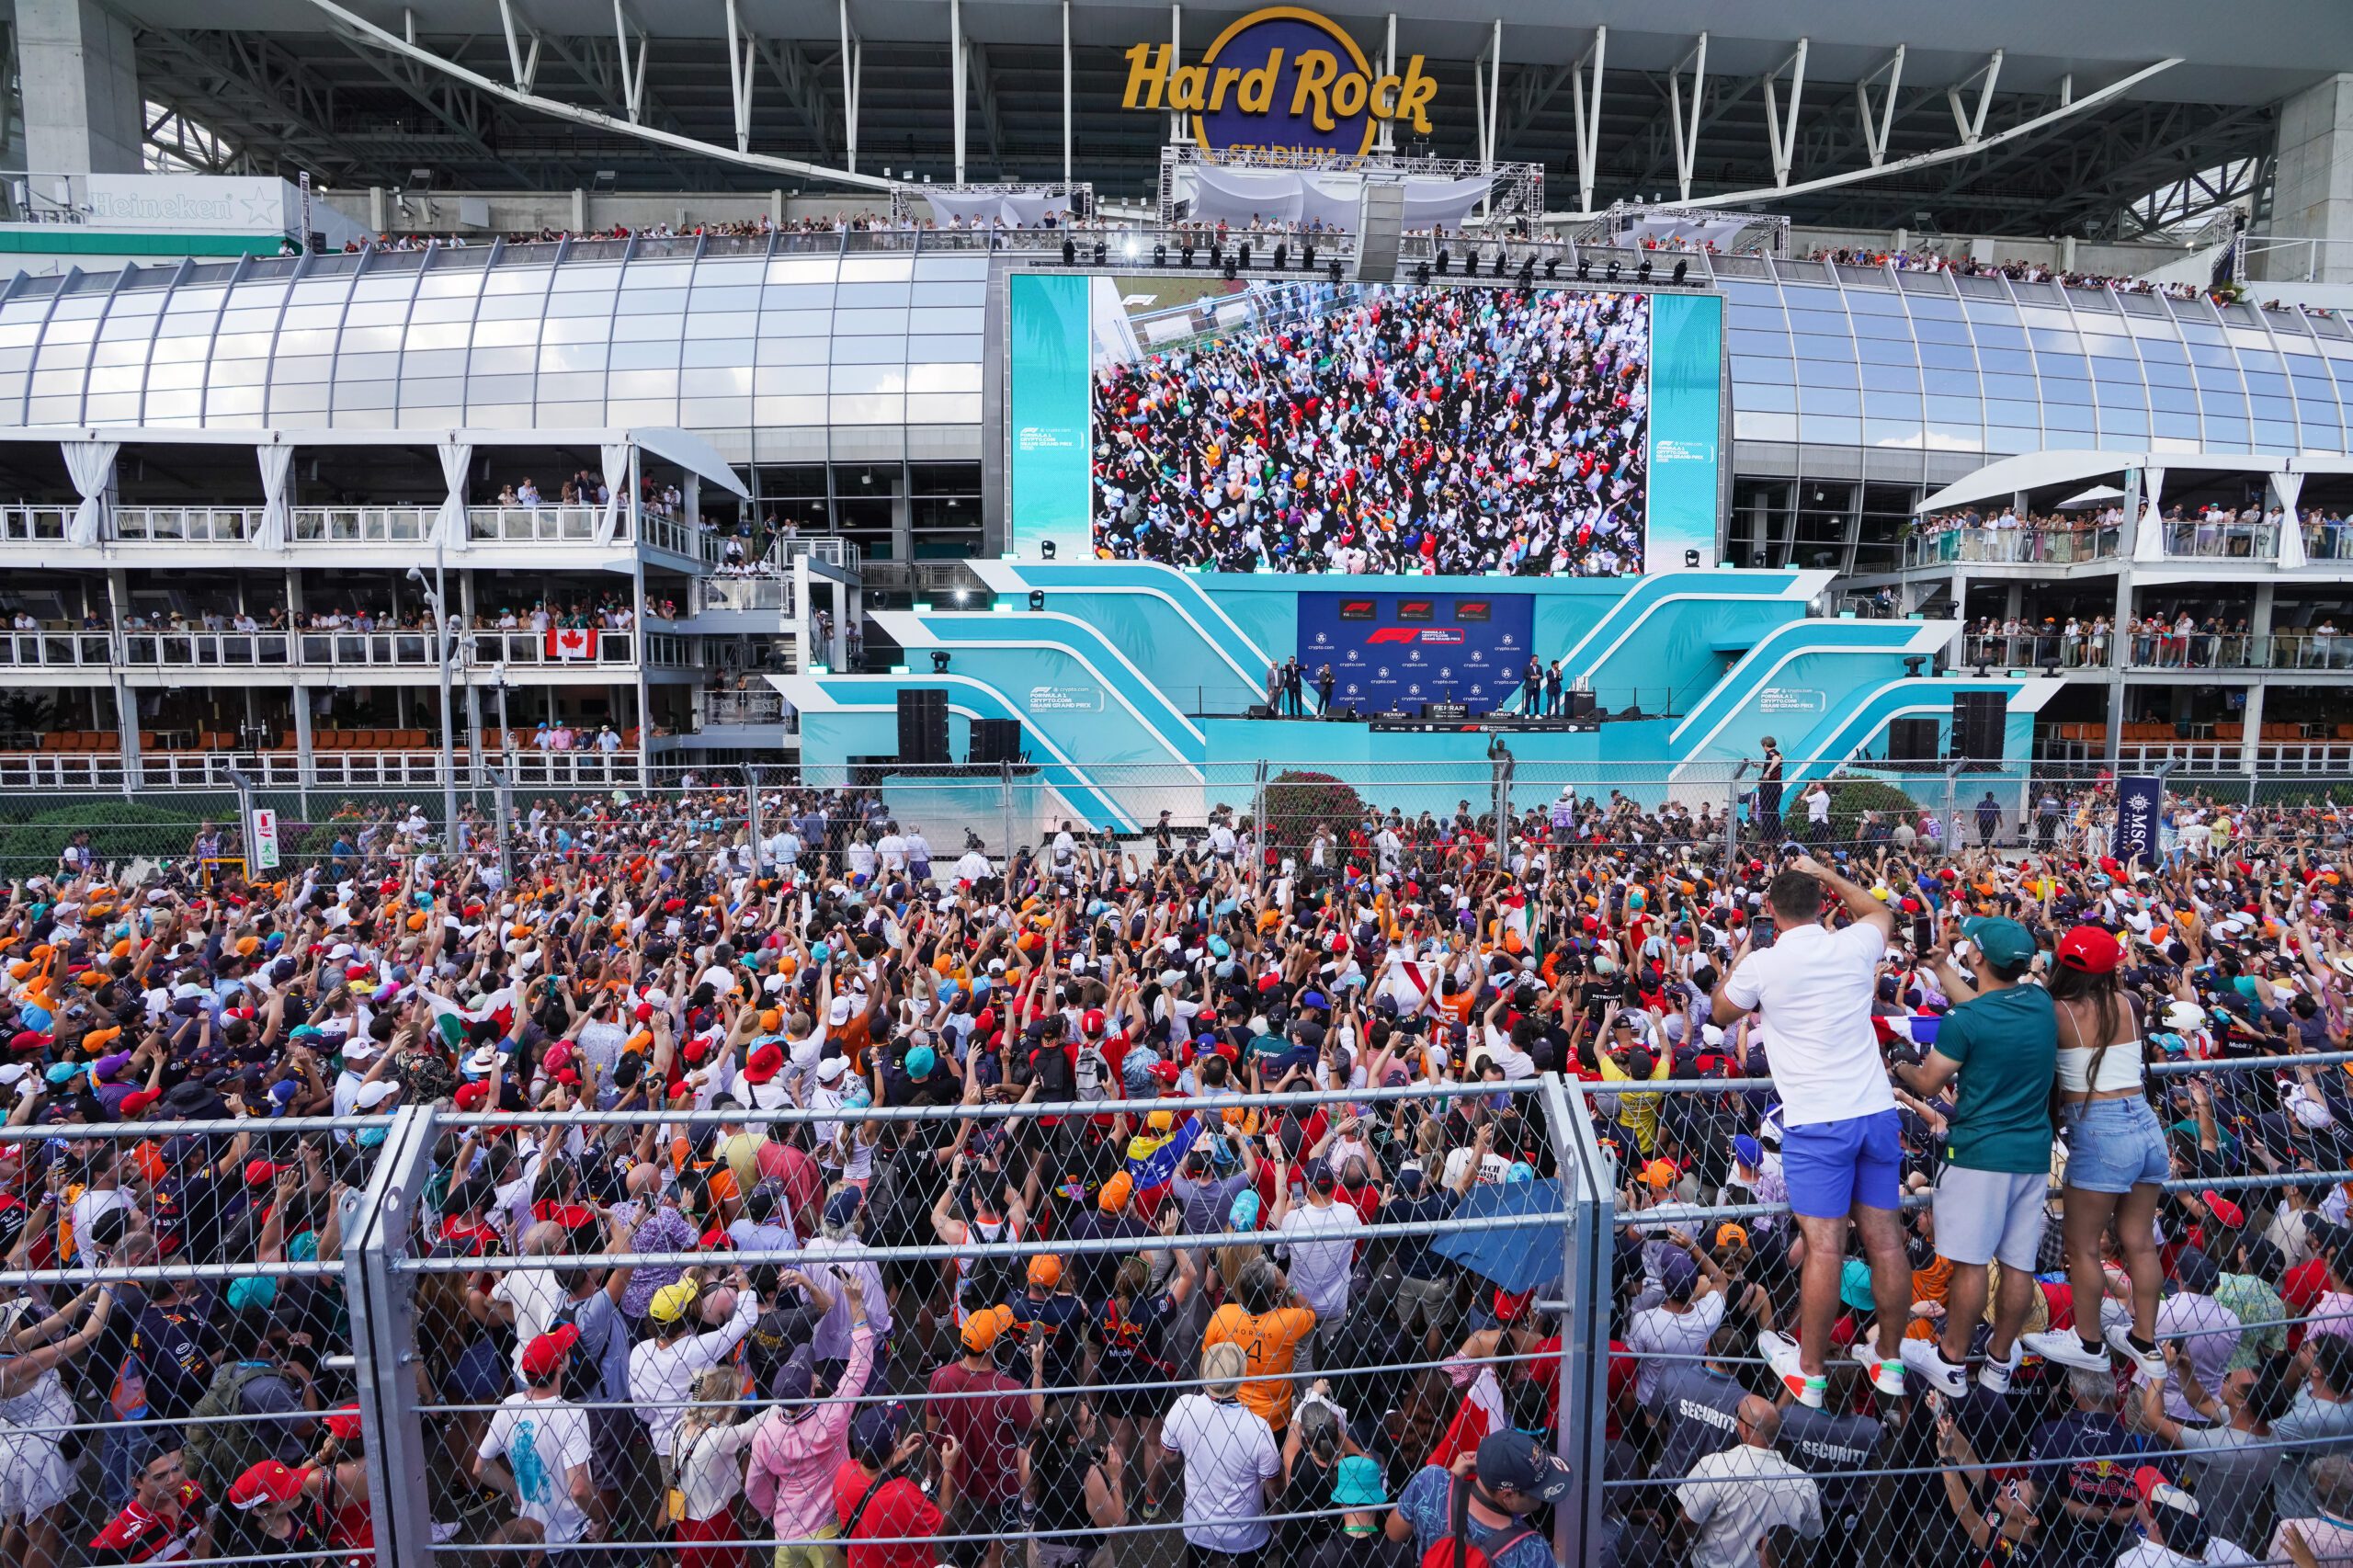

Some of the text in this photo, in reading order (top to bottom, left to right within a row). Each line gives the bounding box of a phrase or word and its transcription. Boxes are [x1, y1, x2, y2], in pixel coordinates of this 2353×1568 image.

[1122, 43, 1438, 135] Hard Rock
[1229, 143, 1336, 165] STADIUM
[91, 192, 232, 220] Heineken
[2131, 813, 2147, 851] MSC
[1245, 1339, 1261, 1364] 4
[2006, 1385, 2031, 1395] Mobil
[1679, 1398, 1737, 1434] SECURITY
[1802, 1440, 1869, 1463] SECURITY
[2069, 1473, 2142, 1502] Red Bull
[122, 1523, 142, 1540] PUMA
